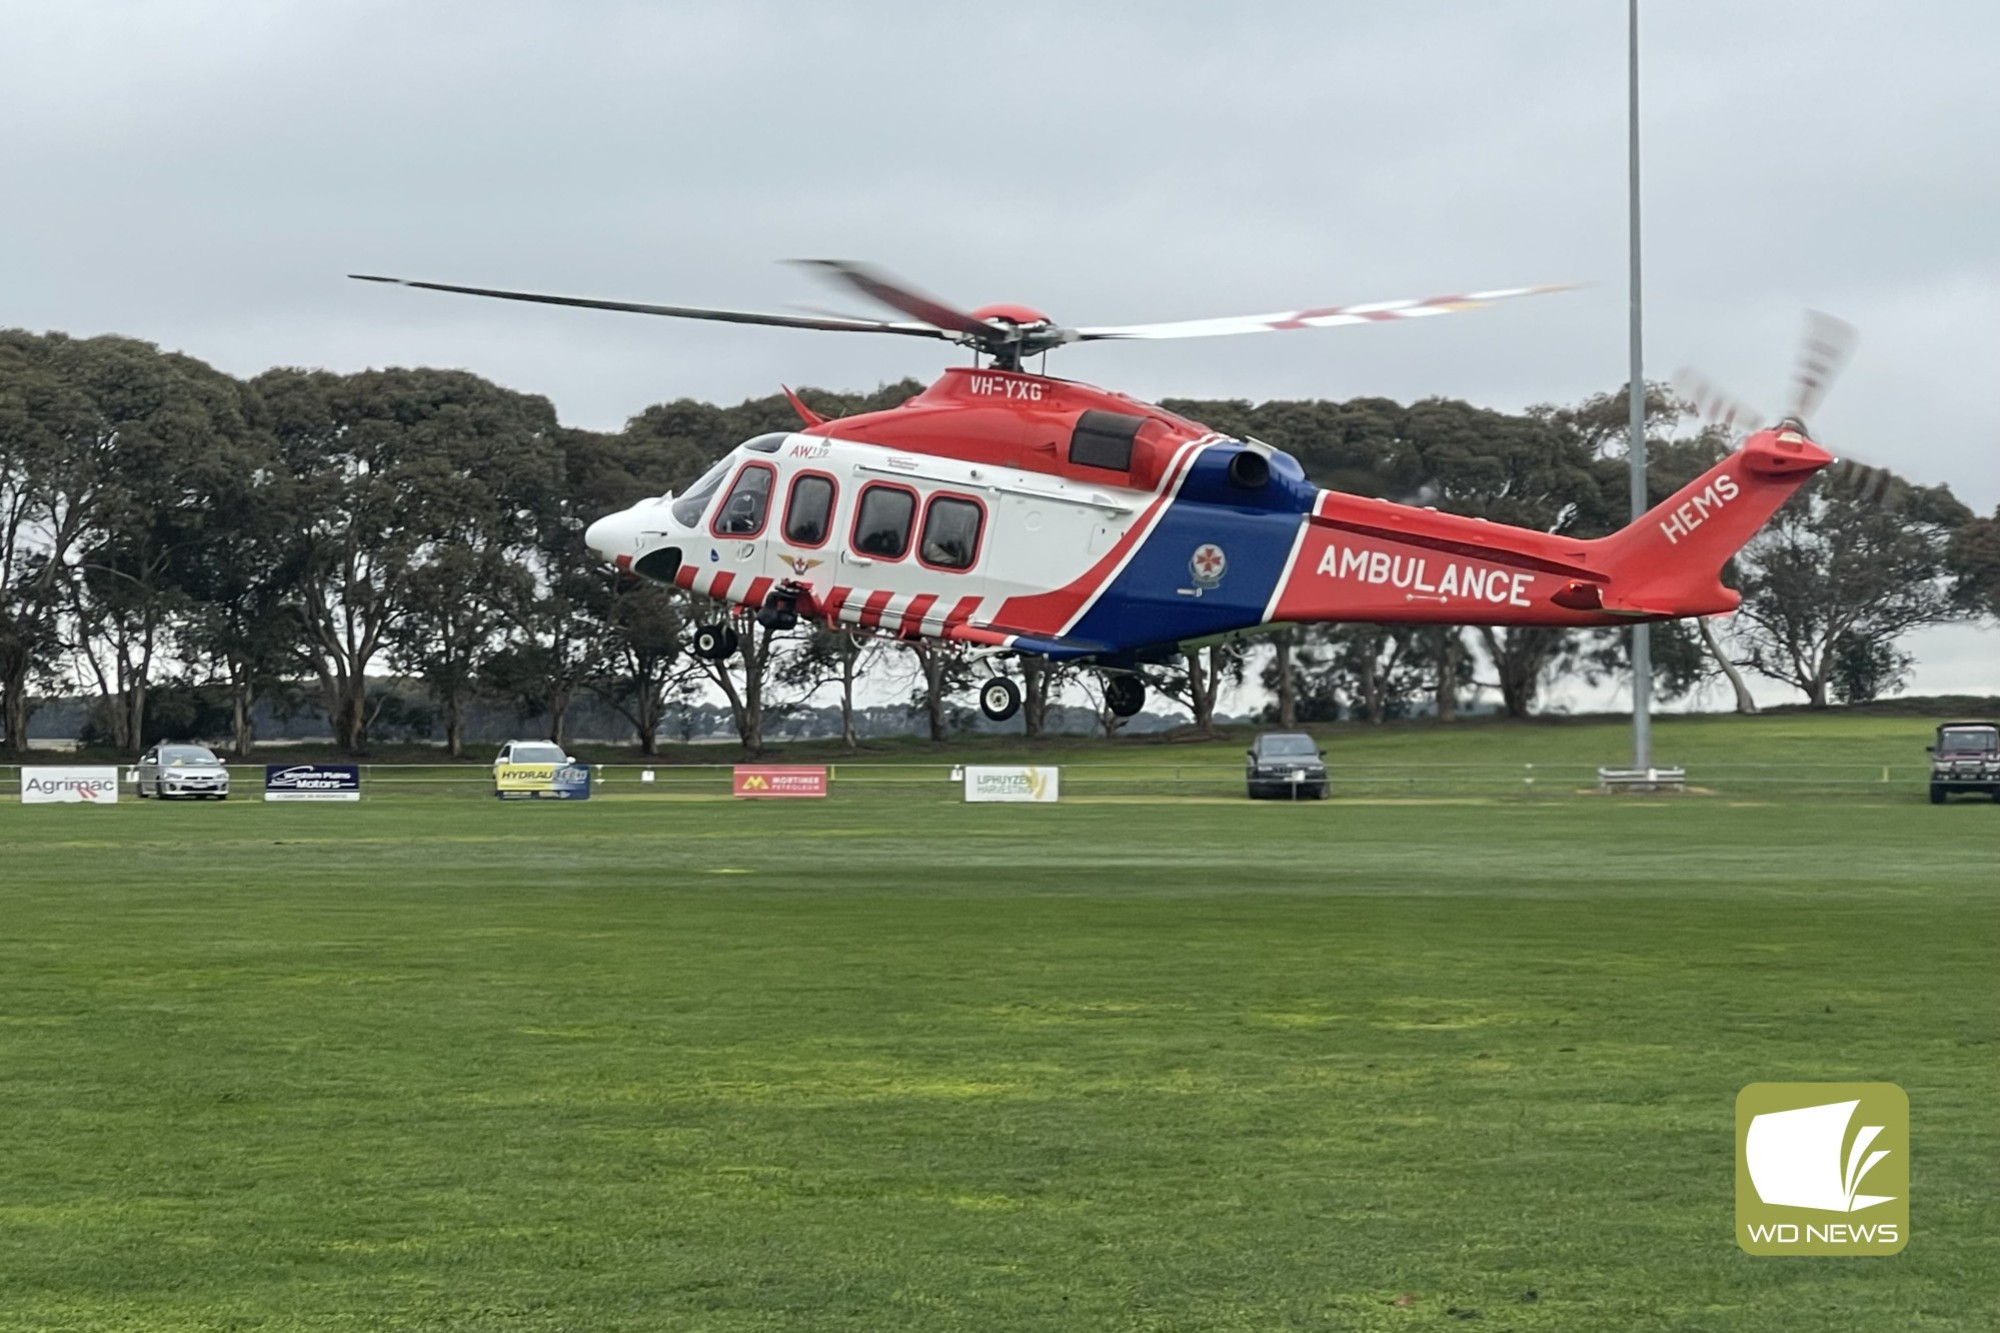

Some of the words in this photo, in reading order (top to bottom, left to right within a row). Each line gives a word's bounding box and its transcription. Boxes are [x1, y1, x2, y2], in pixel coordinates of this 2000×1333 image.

[971, 375, 1043, 401] VH-YXG
[1660, 474, 1740, 545] HEMS
[1316, 544, 1535, 608] AMBULANCE
[25, 776, 115, 794] Agrimac
